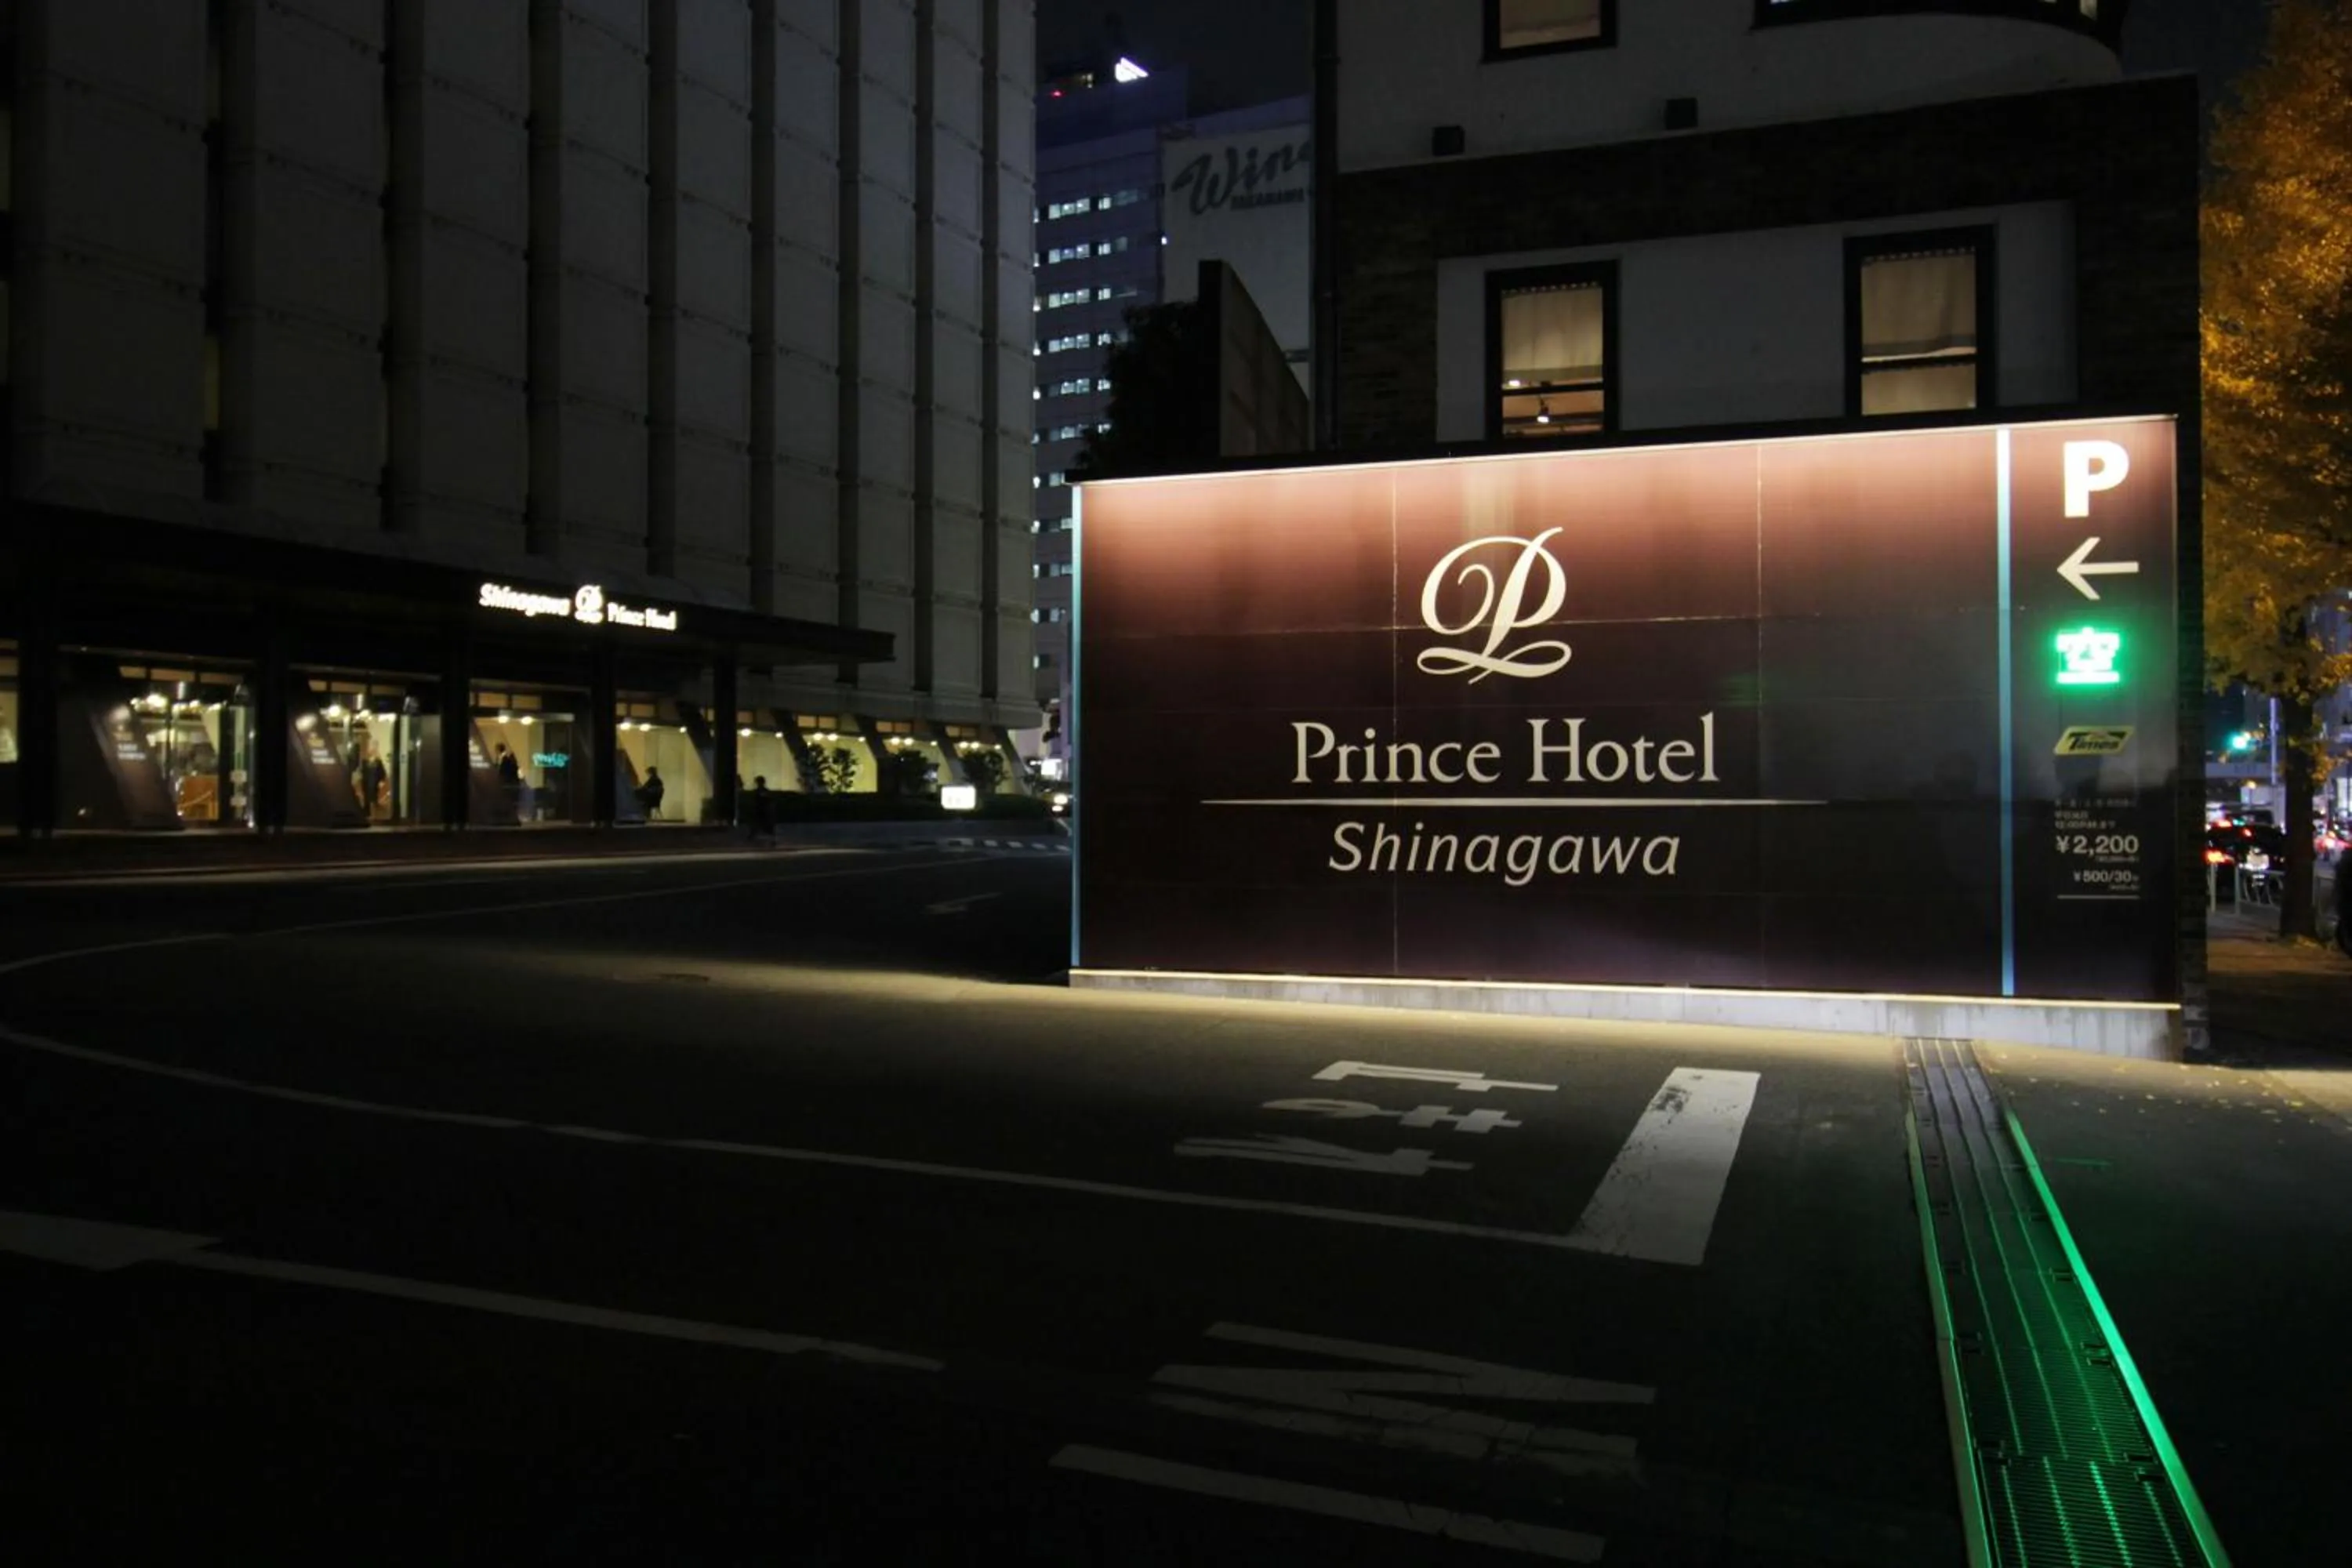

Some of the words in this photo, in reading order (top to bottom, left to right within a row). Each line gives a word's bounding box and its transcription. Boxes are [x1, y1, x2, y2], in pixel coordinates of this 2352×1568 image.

[2063, 440, 2129, 518] P
[1291, 721, 1501, 783] Prince
[1527, 711, 1720, 783] Hotel
[1328, 822, 1681, 886] Shinagawa
[2056, 834, 2139, 856] ¥2,200
